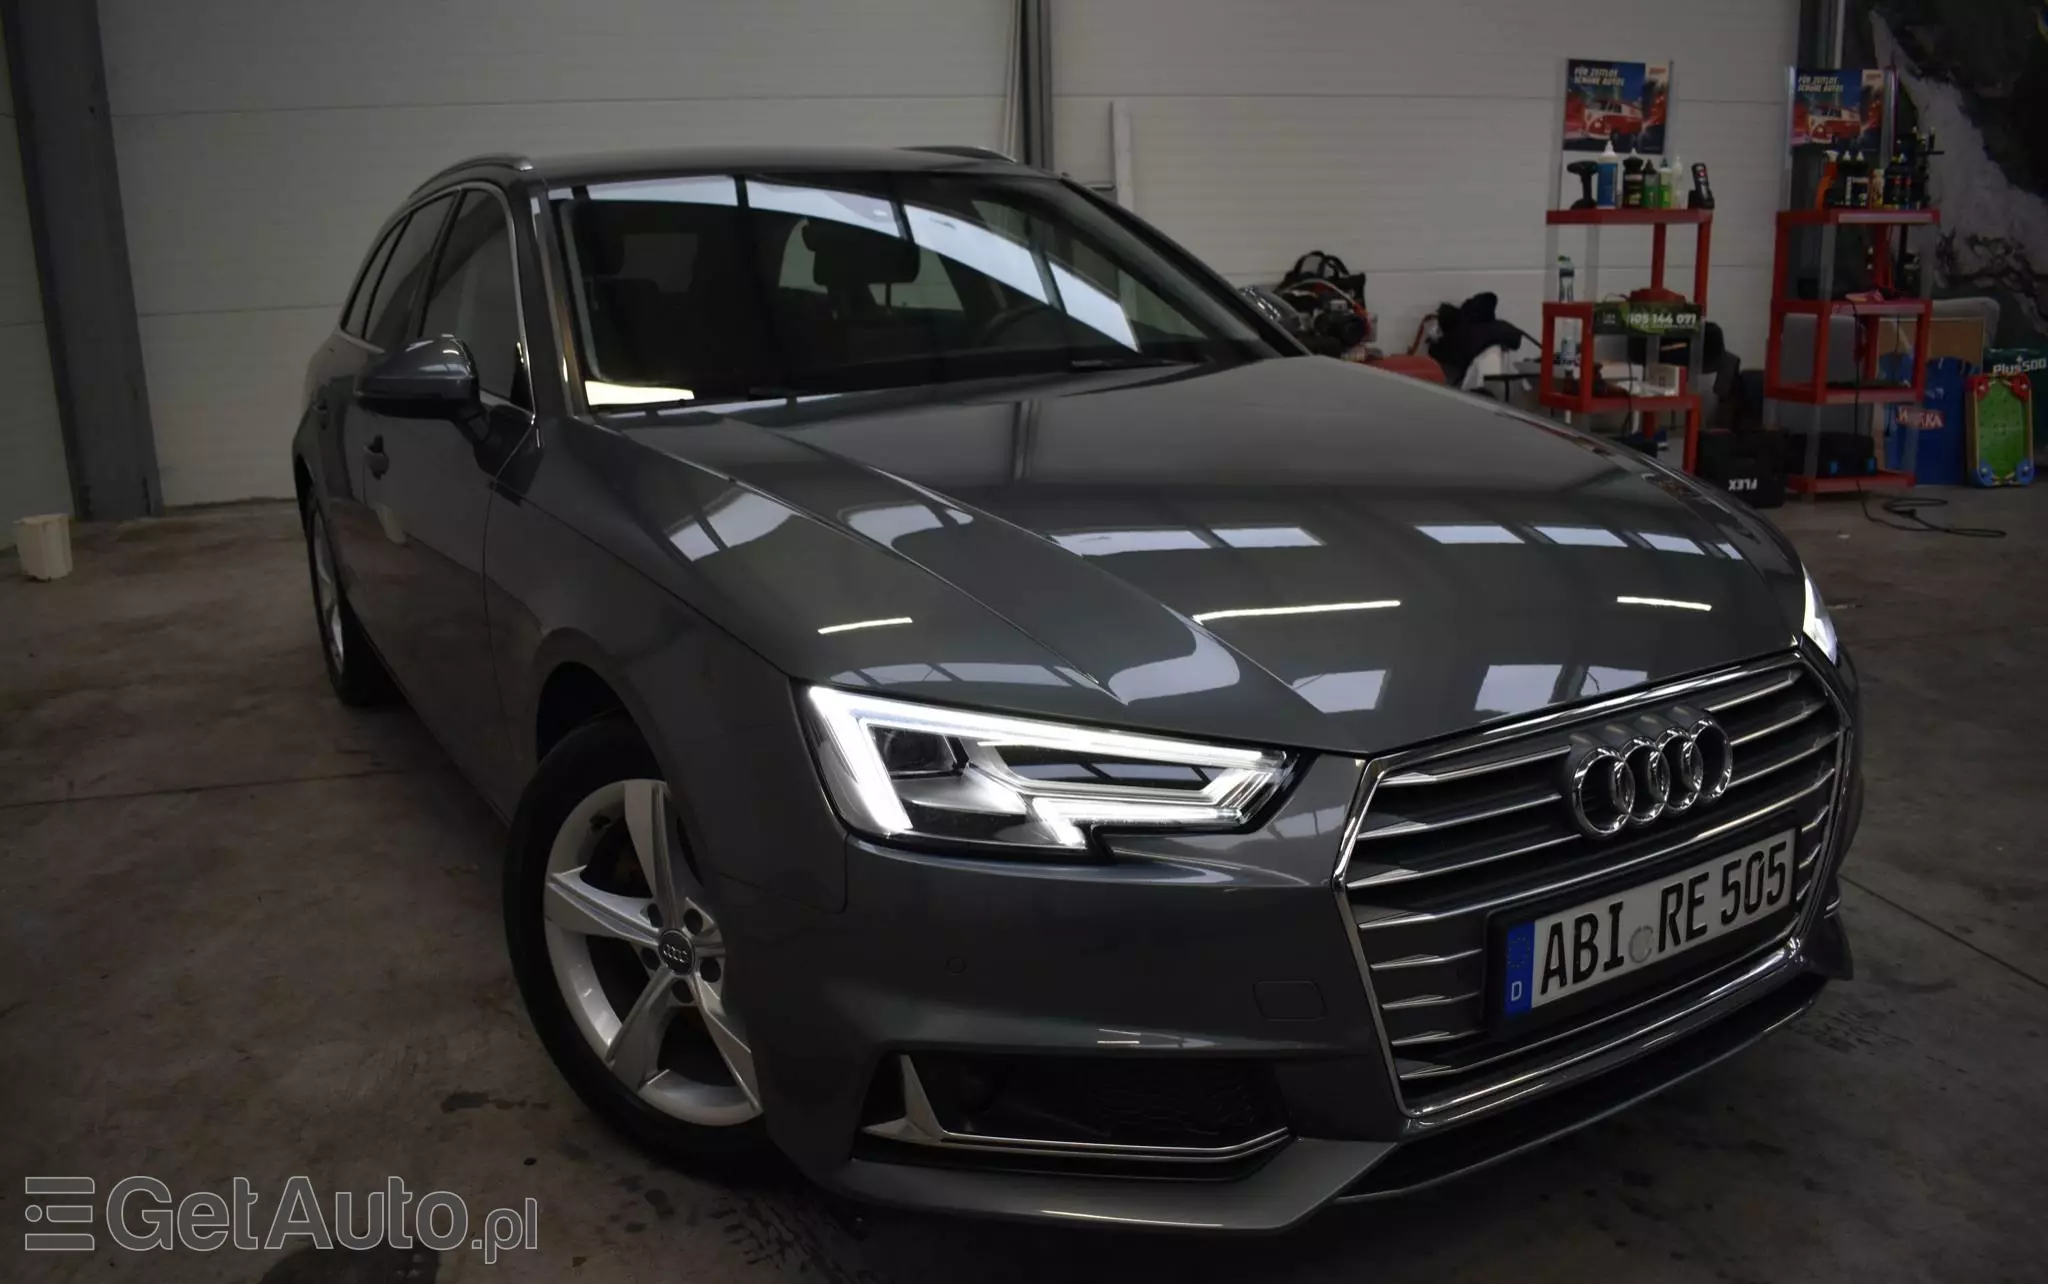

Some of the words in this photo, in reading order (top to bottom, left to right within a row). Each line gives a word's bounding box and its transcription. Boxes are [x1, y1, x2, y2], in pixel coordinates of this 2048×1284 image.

[1992, 357, 2047, 374] Plus500
[1728, 478, 1758, 491] FLEX
[1540, 901, 1625, 996] ABI
[1658, 871, 1710, 953] RE
[1720, 841, 1787, 926] 505
[1511, 981, 1523, 1002] D
